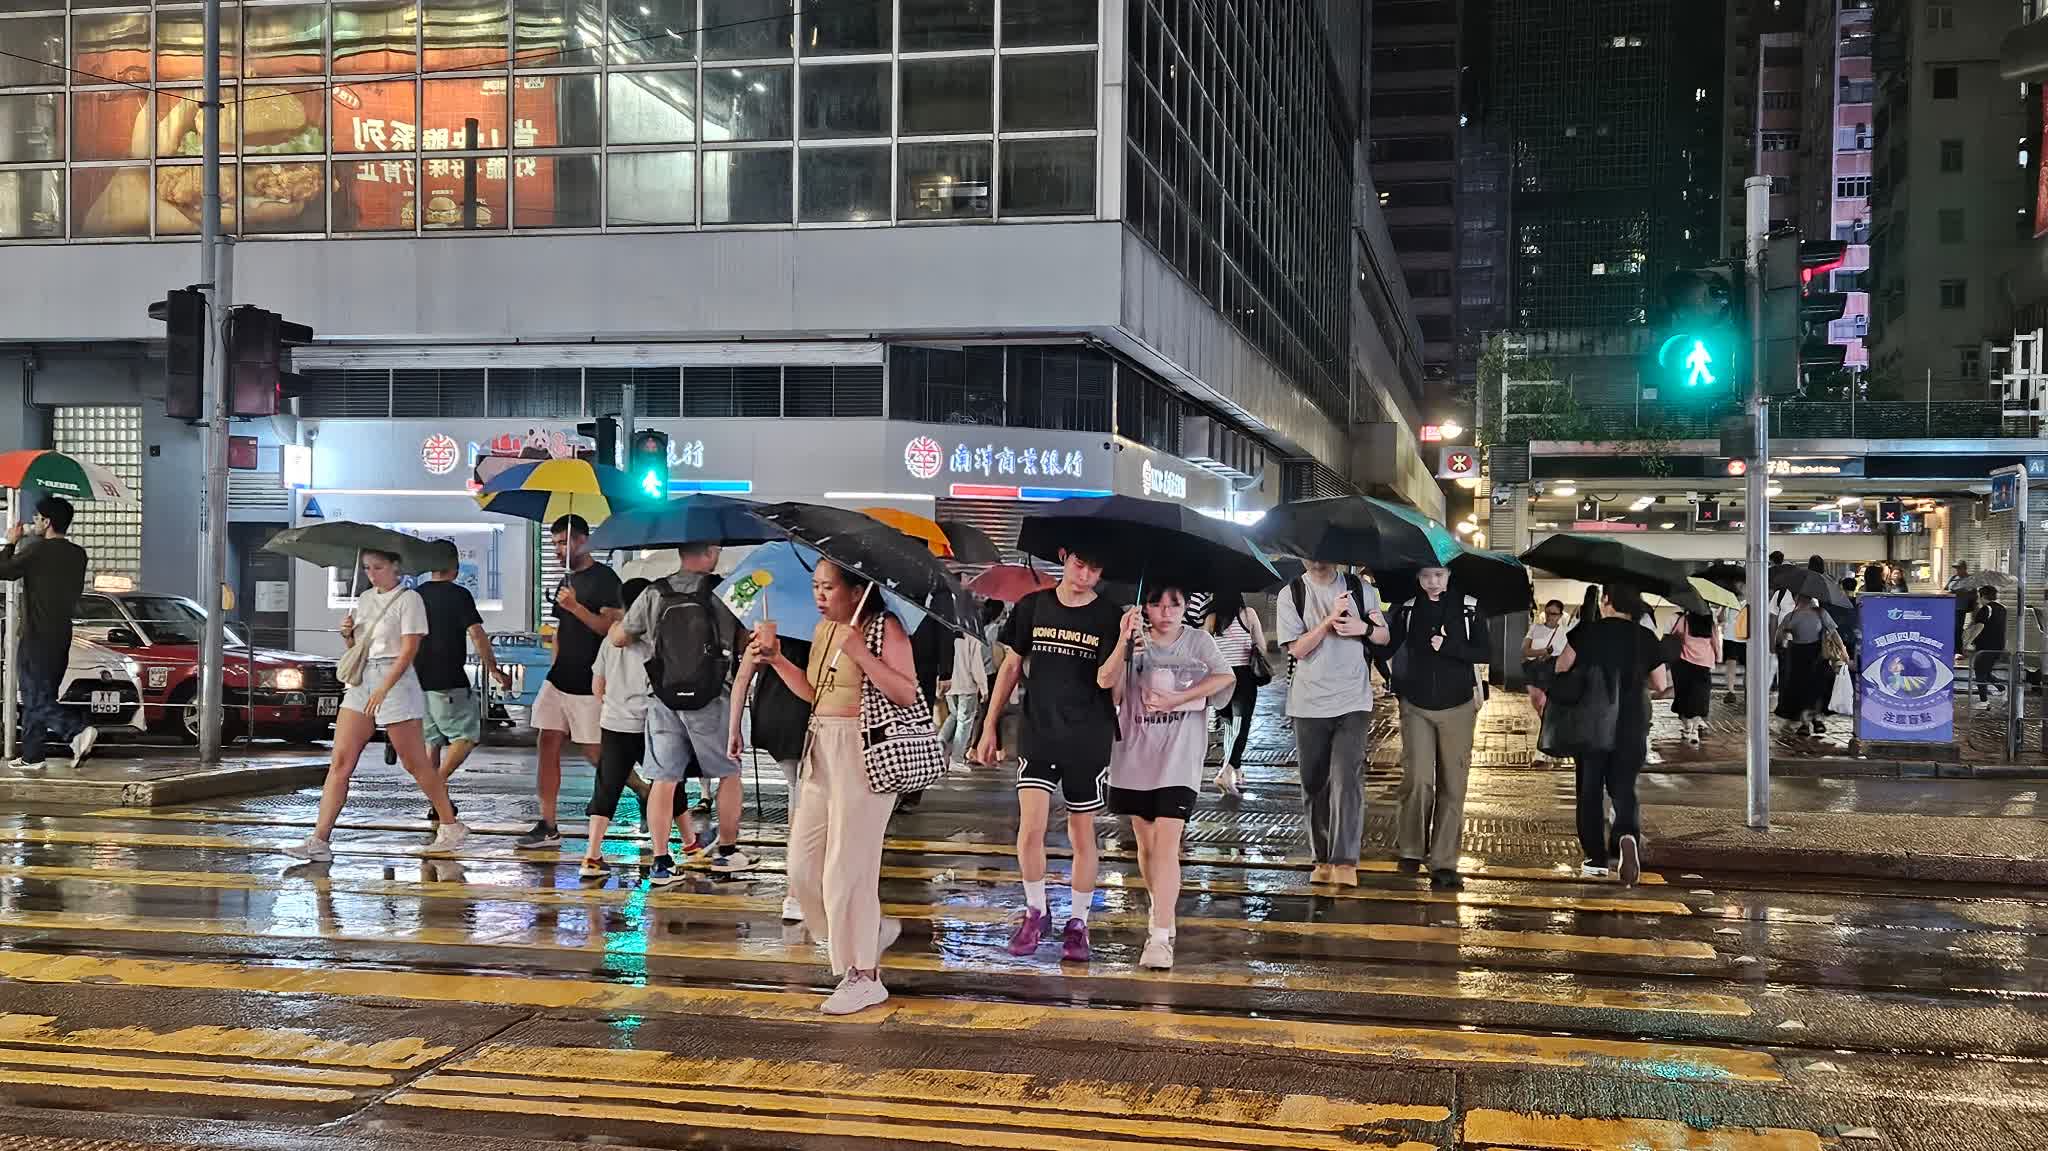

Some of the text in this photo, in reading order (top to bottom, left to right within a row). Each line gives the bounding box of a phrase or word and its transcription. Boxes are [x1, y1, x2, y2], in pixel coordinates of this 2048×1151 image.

[950, 444, 1083, 477] 南洋商業銀行
[1057, 629, 1081, 643] FUNG
